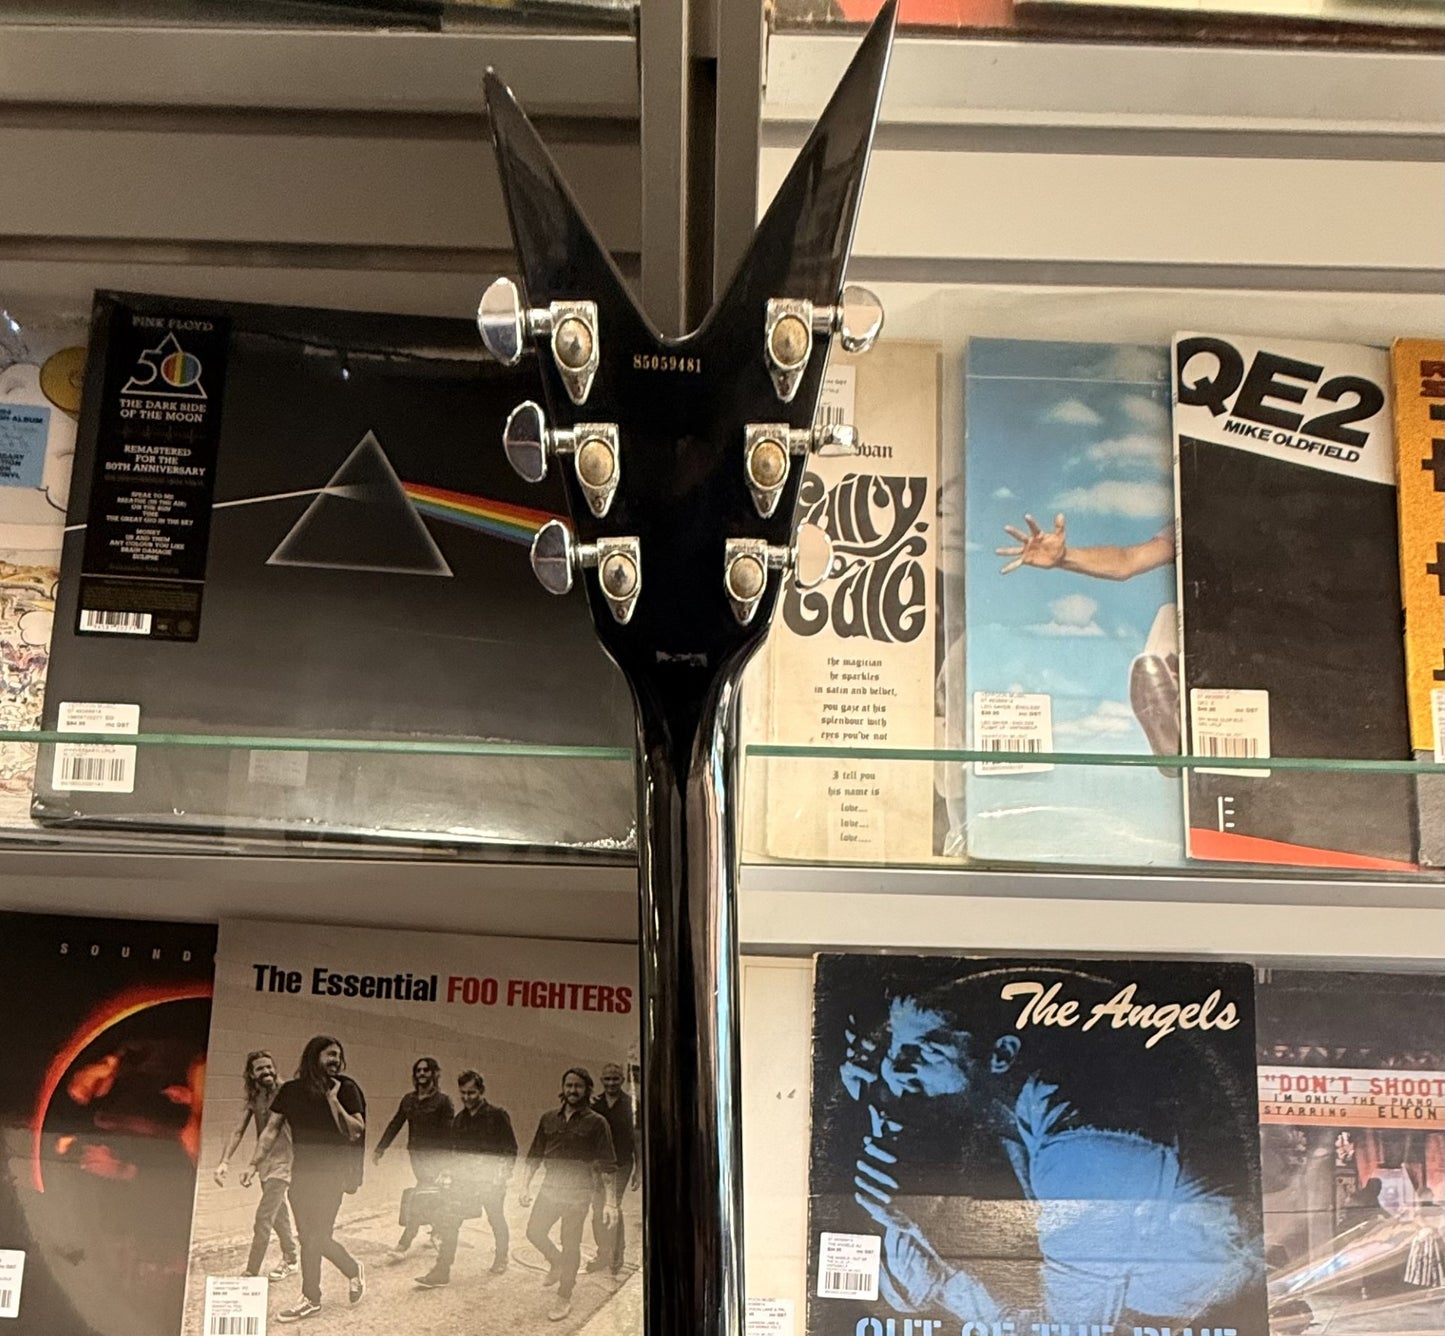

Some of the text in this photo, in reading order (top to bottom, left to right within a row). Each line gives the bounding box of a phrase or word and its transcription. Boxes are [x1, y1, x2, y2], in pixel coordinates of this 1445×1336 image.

[132, 315, 214, 331] PINK FLOYD
[1177, 336, 1386, 449] QE2
[120, 398, 207, 413] THE DARK SIDE
[120, 408, 203, 422] OF THE MOON
[1222, 419, 1361, 464] MIKE OLDFIELD
[123, 444, 192, 457] REMASTERED
[135, 454, 179, 466] FOR THE
[133, 463, 206, 476] ANNIVERSARY
[253, 964, 633, 1014] The Essential FOO FIGHTERS
[1000, 981, 1241, 1049] The Angels
[1369, 1076, 1445, 1097] SHOOT
[1305, 1094, 1339, 1105] ONLY
[1352, 1096, 1376, 1106] THE
[1391, 1097, 1433, 1108] PIANO
[1264, 1105, 1438, 1120] STARRING ELTON
